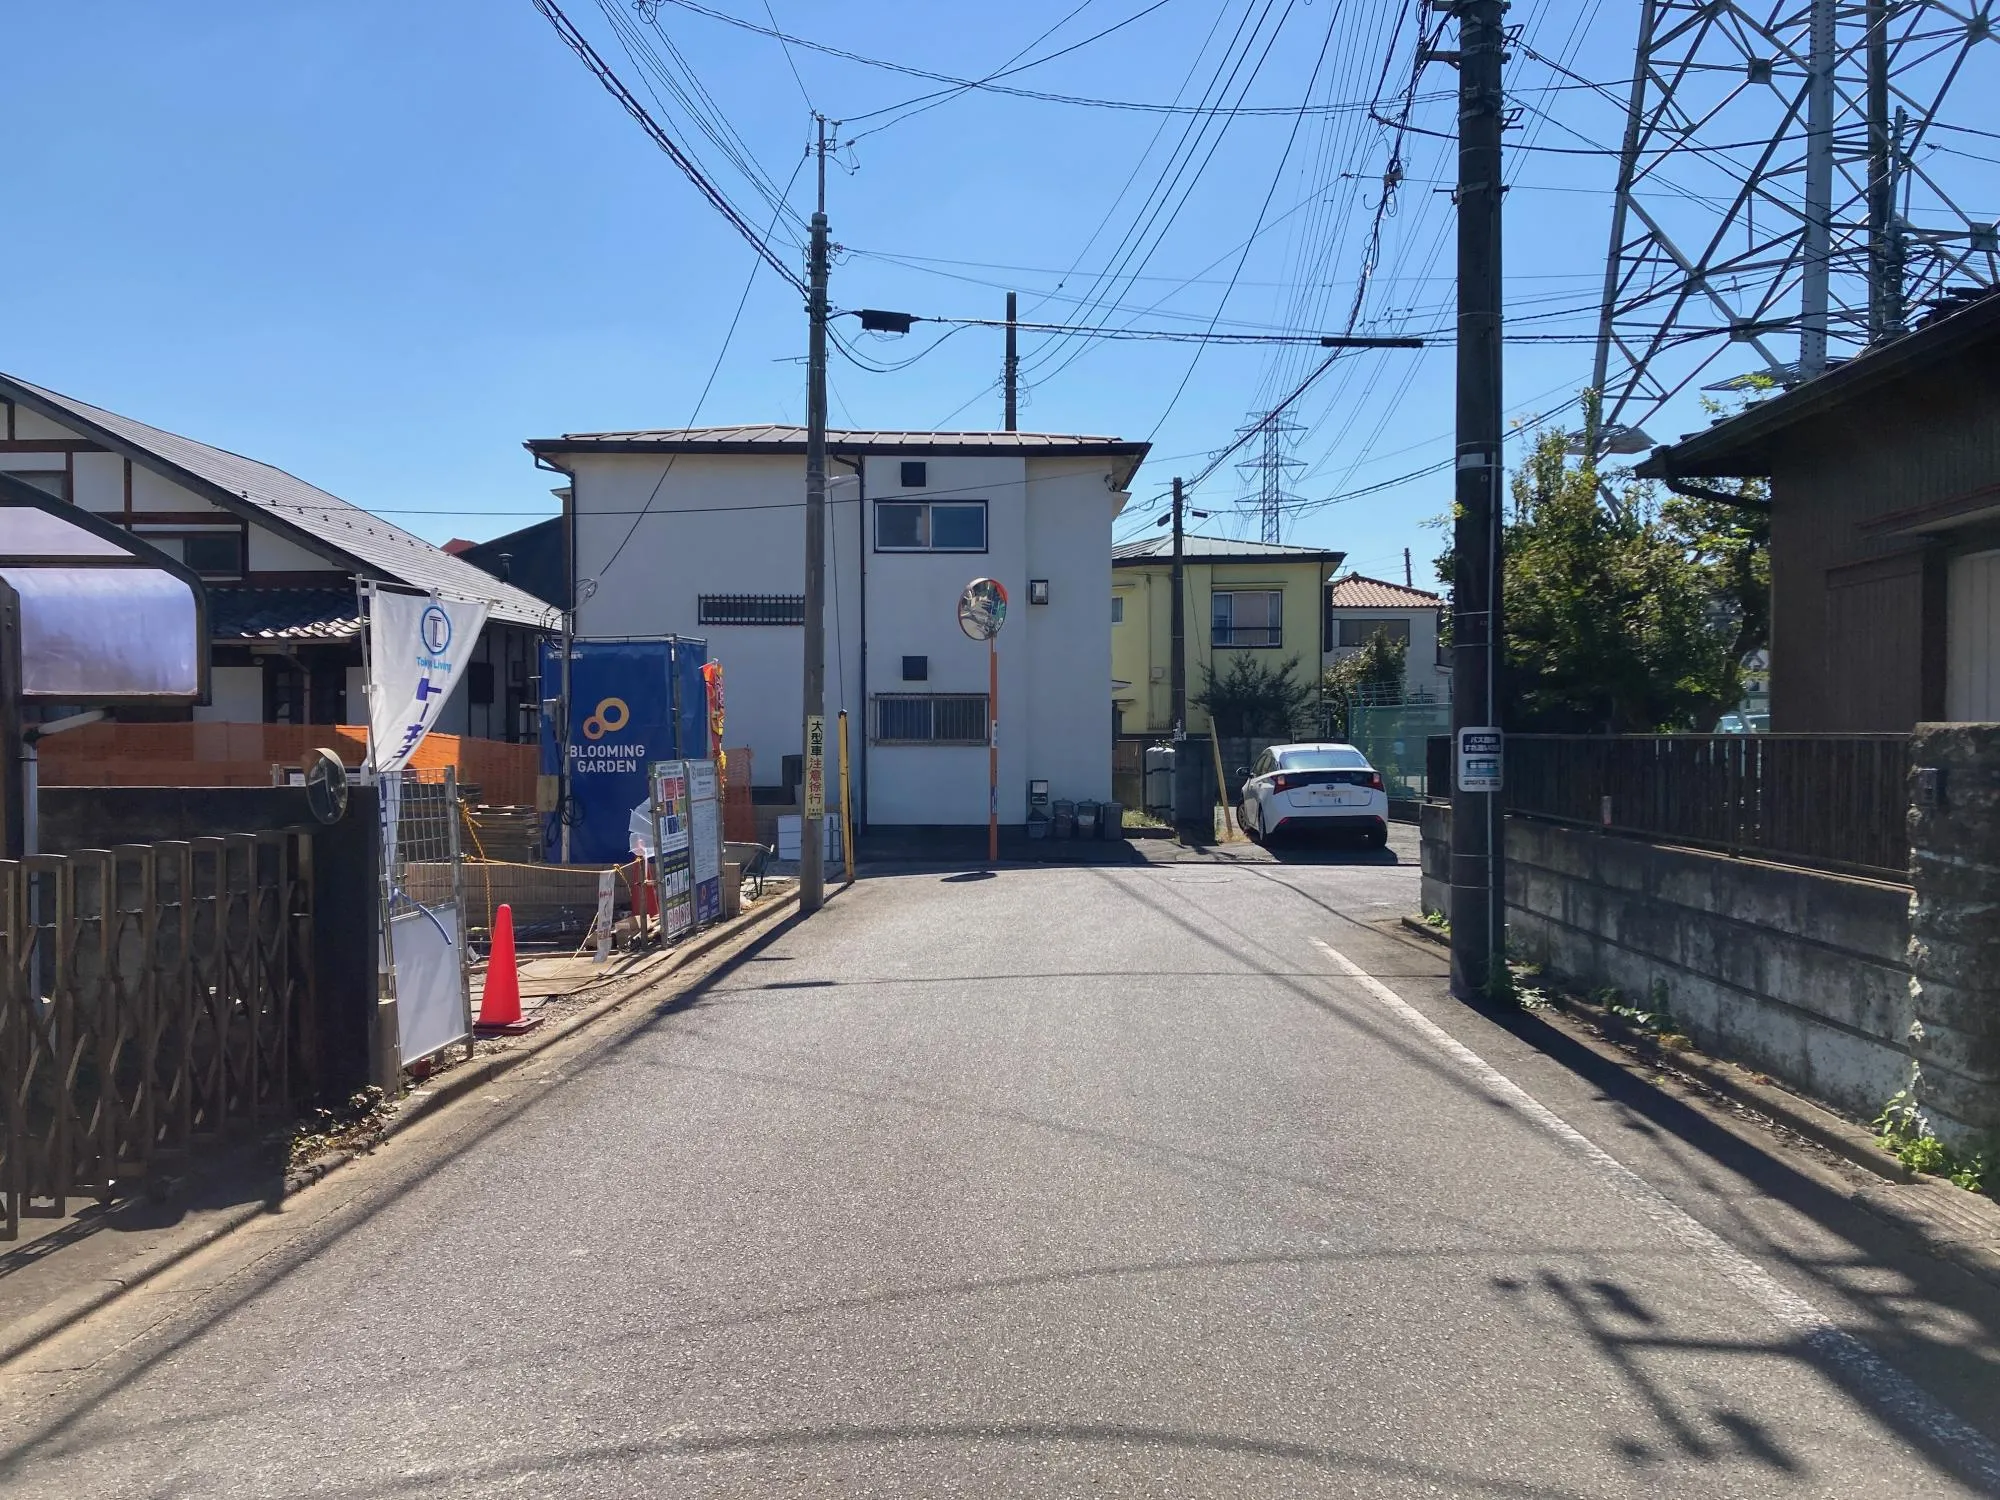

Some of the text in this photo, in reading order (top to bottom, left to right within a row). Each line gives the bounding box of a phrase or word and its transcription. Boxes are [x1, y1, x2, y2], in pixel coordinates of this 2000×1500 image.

[433, 659, 452, 673] Living
[570, 744, 645, 758] BLOOMING
[577, 759, 637, 773] GARDEN
[808, 720, 823, 804] 大型車注意徐行
